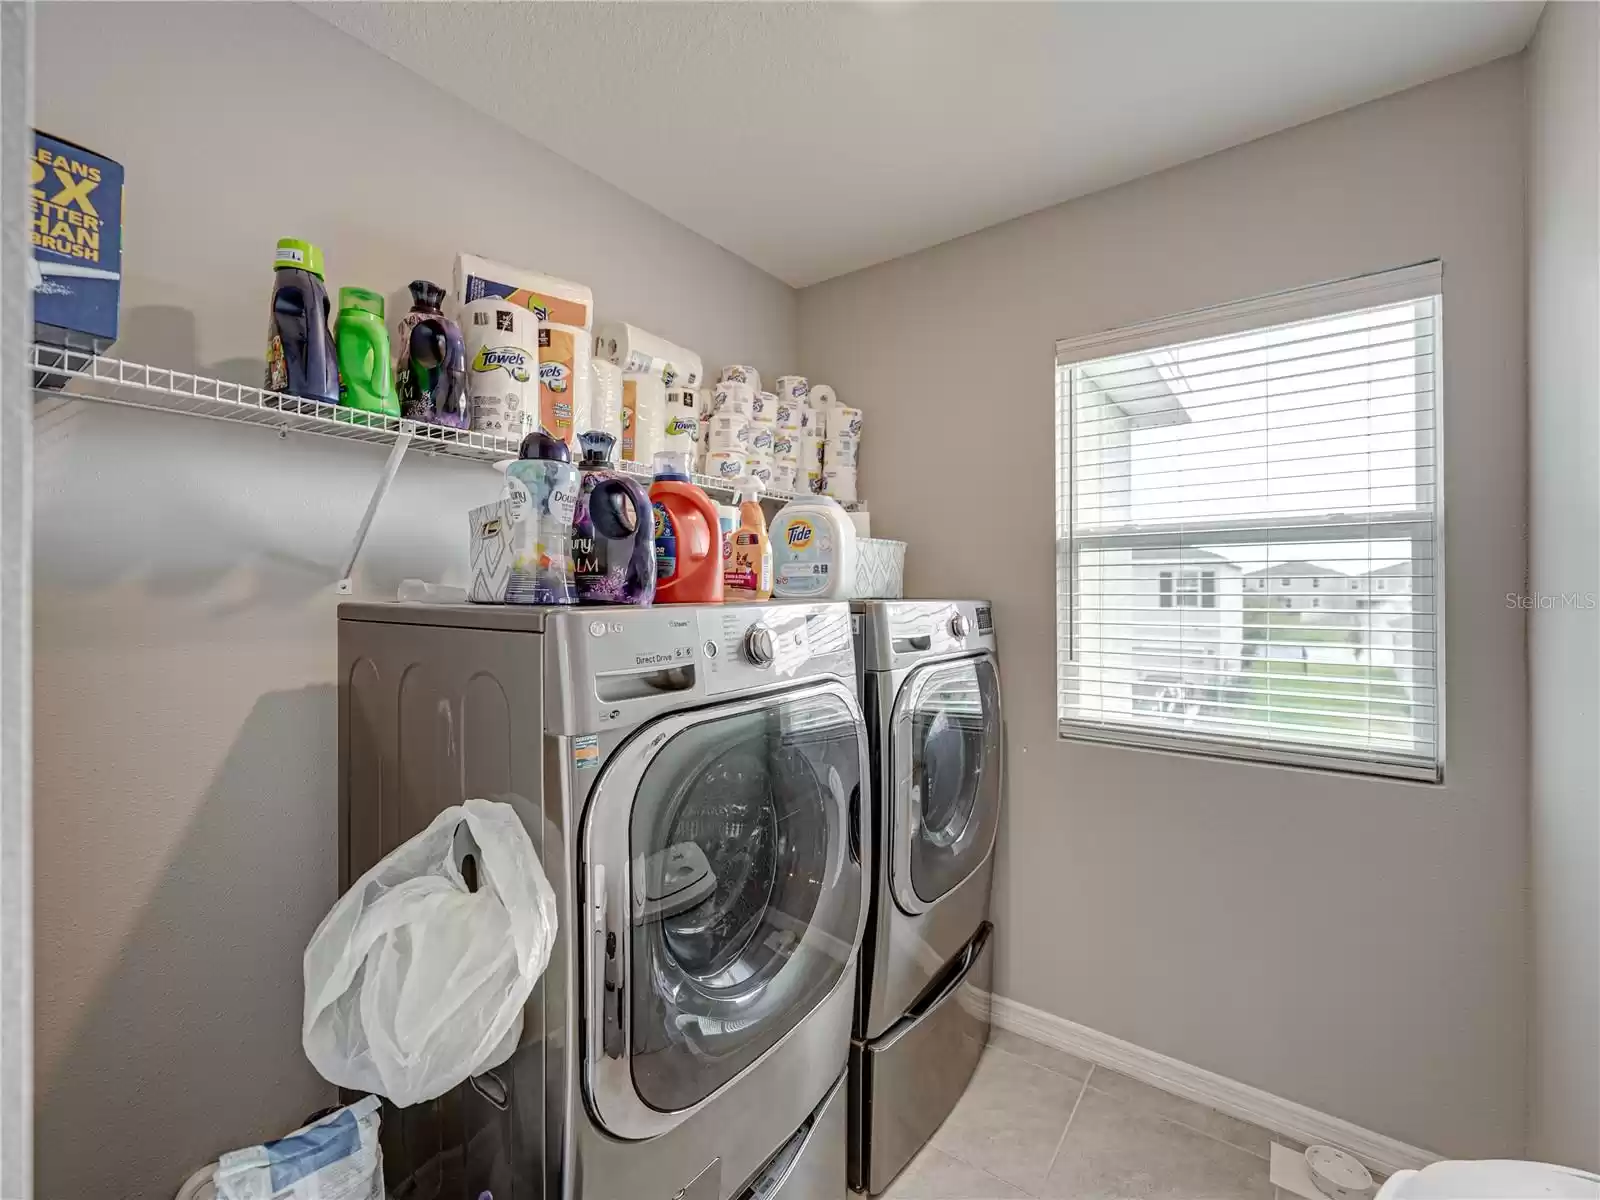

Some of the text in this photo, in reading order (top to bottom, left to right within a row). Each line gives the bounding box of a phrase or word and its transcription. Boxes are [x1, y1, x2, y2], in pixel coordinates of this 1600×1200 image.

[482, 352, 526, 366] Towels
[788, 526, 812, 544] Tide
[636, 656, 656, 665] Direct
[656, 654, 672, 663] Drive
